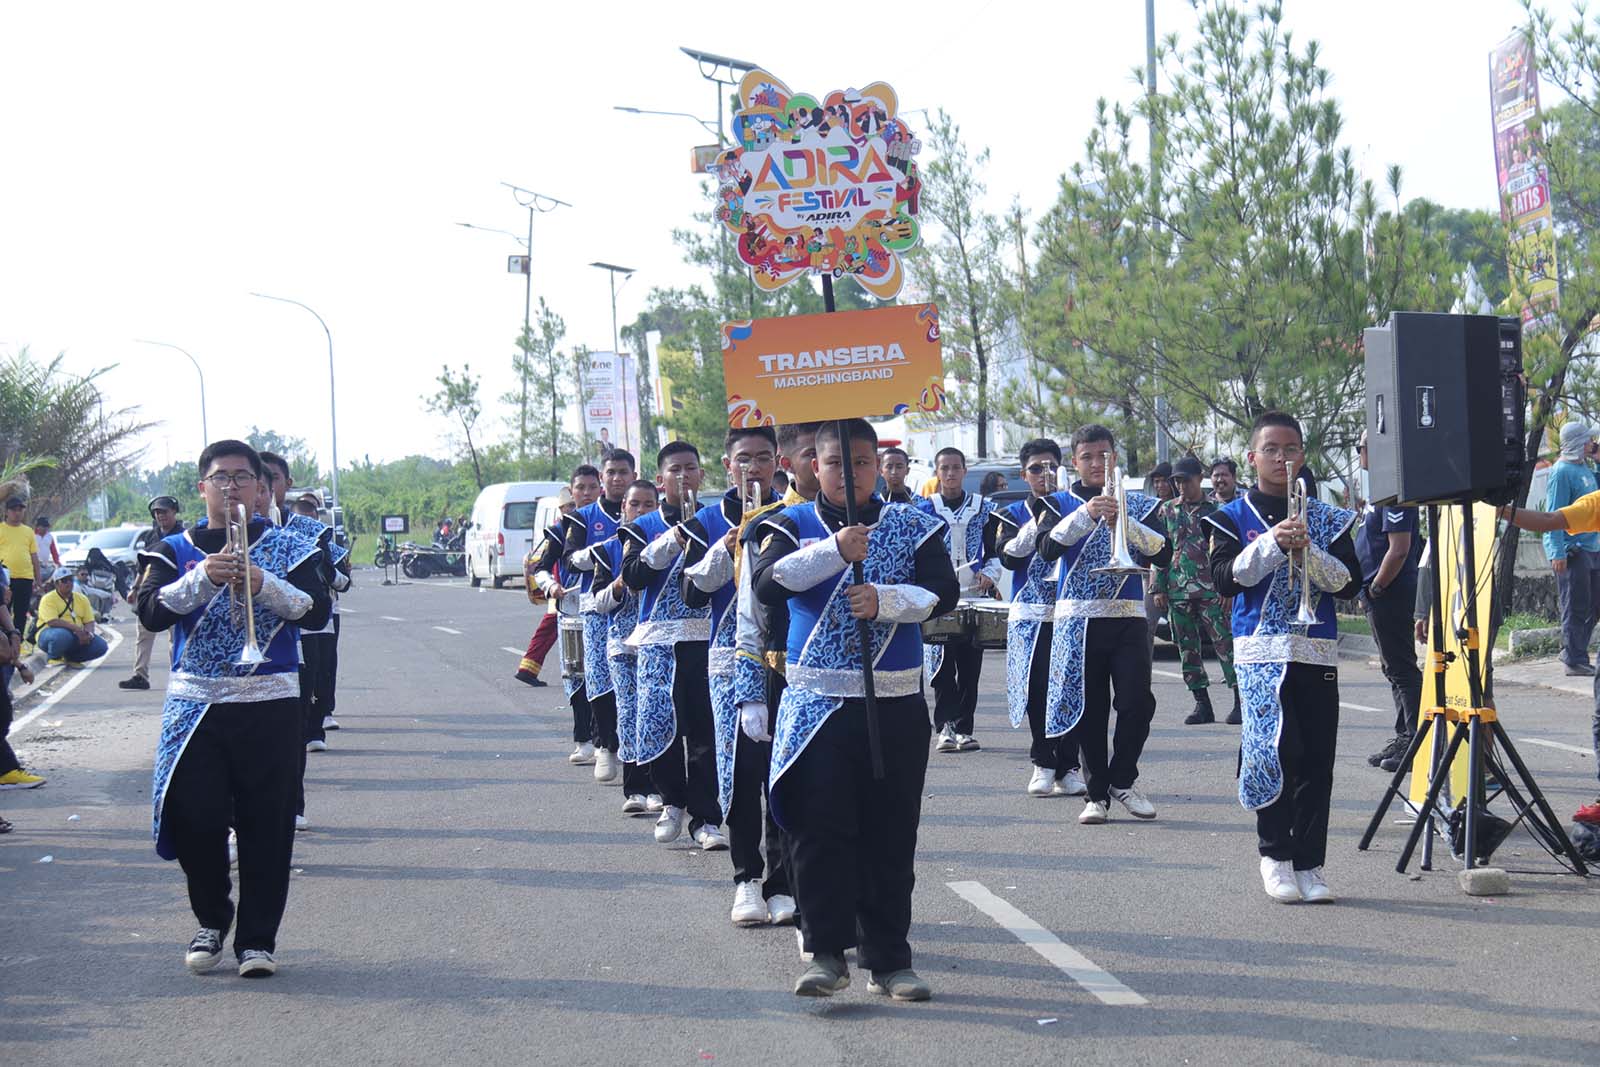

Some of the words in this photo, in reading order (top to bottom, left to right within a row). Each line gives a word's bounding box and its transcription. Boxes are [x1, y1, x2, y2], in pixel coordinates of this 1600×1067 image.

[752, 144, 894, 192] ADIRA
[1508, 186, 1541, 216] RATIS
[805, 210, 852, 222] ADIRA
[758, 343, 906, 372] TRANSERA
[774, 367, 894, 389] MARCHINGBAND
